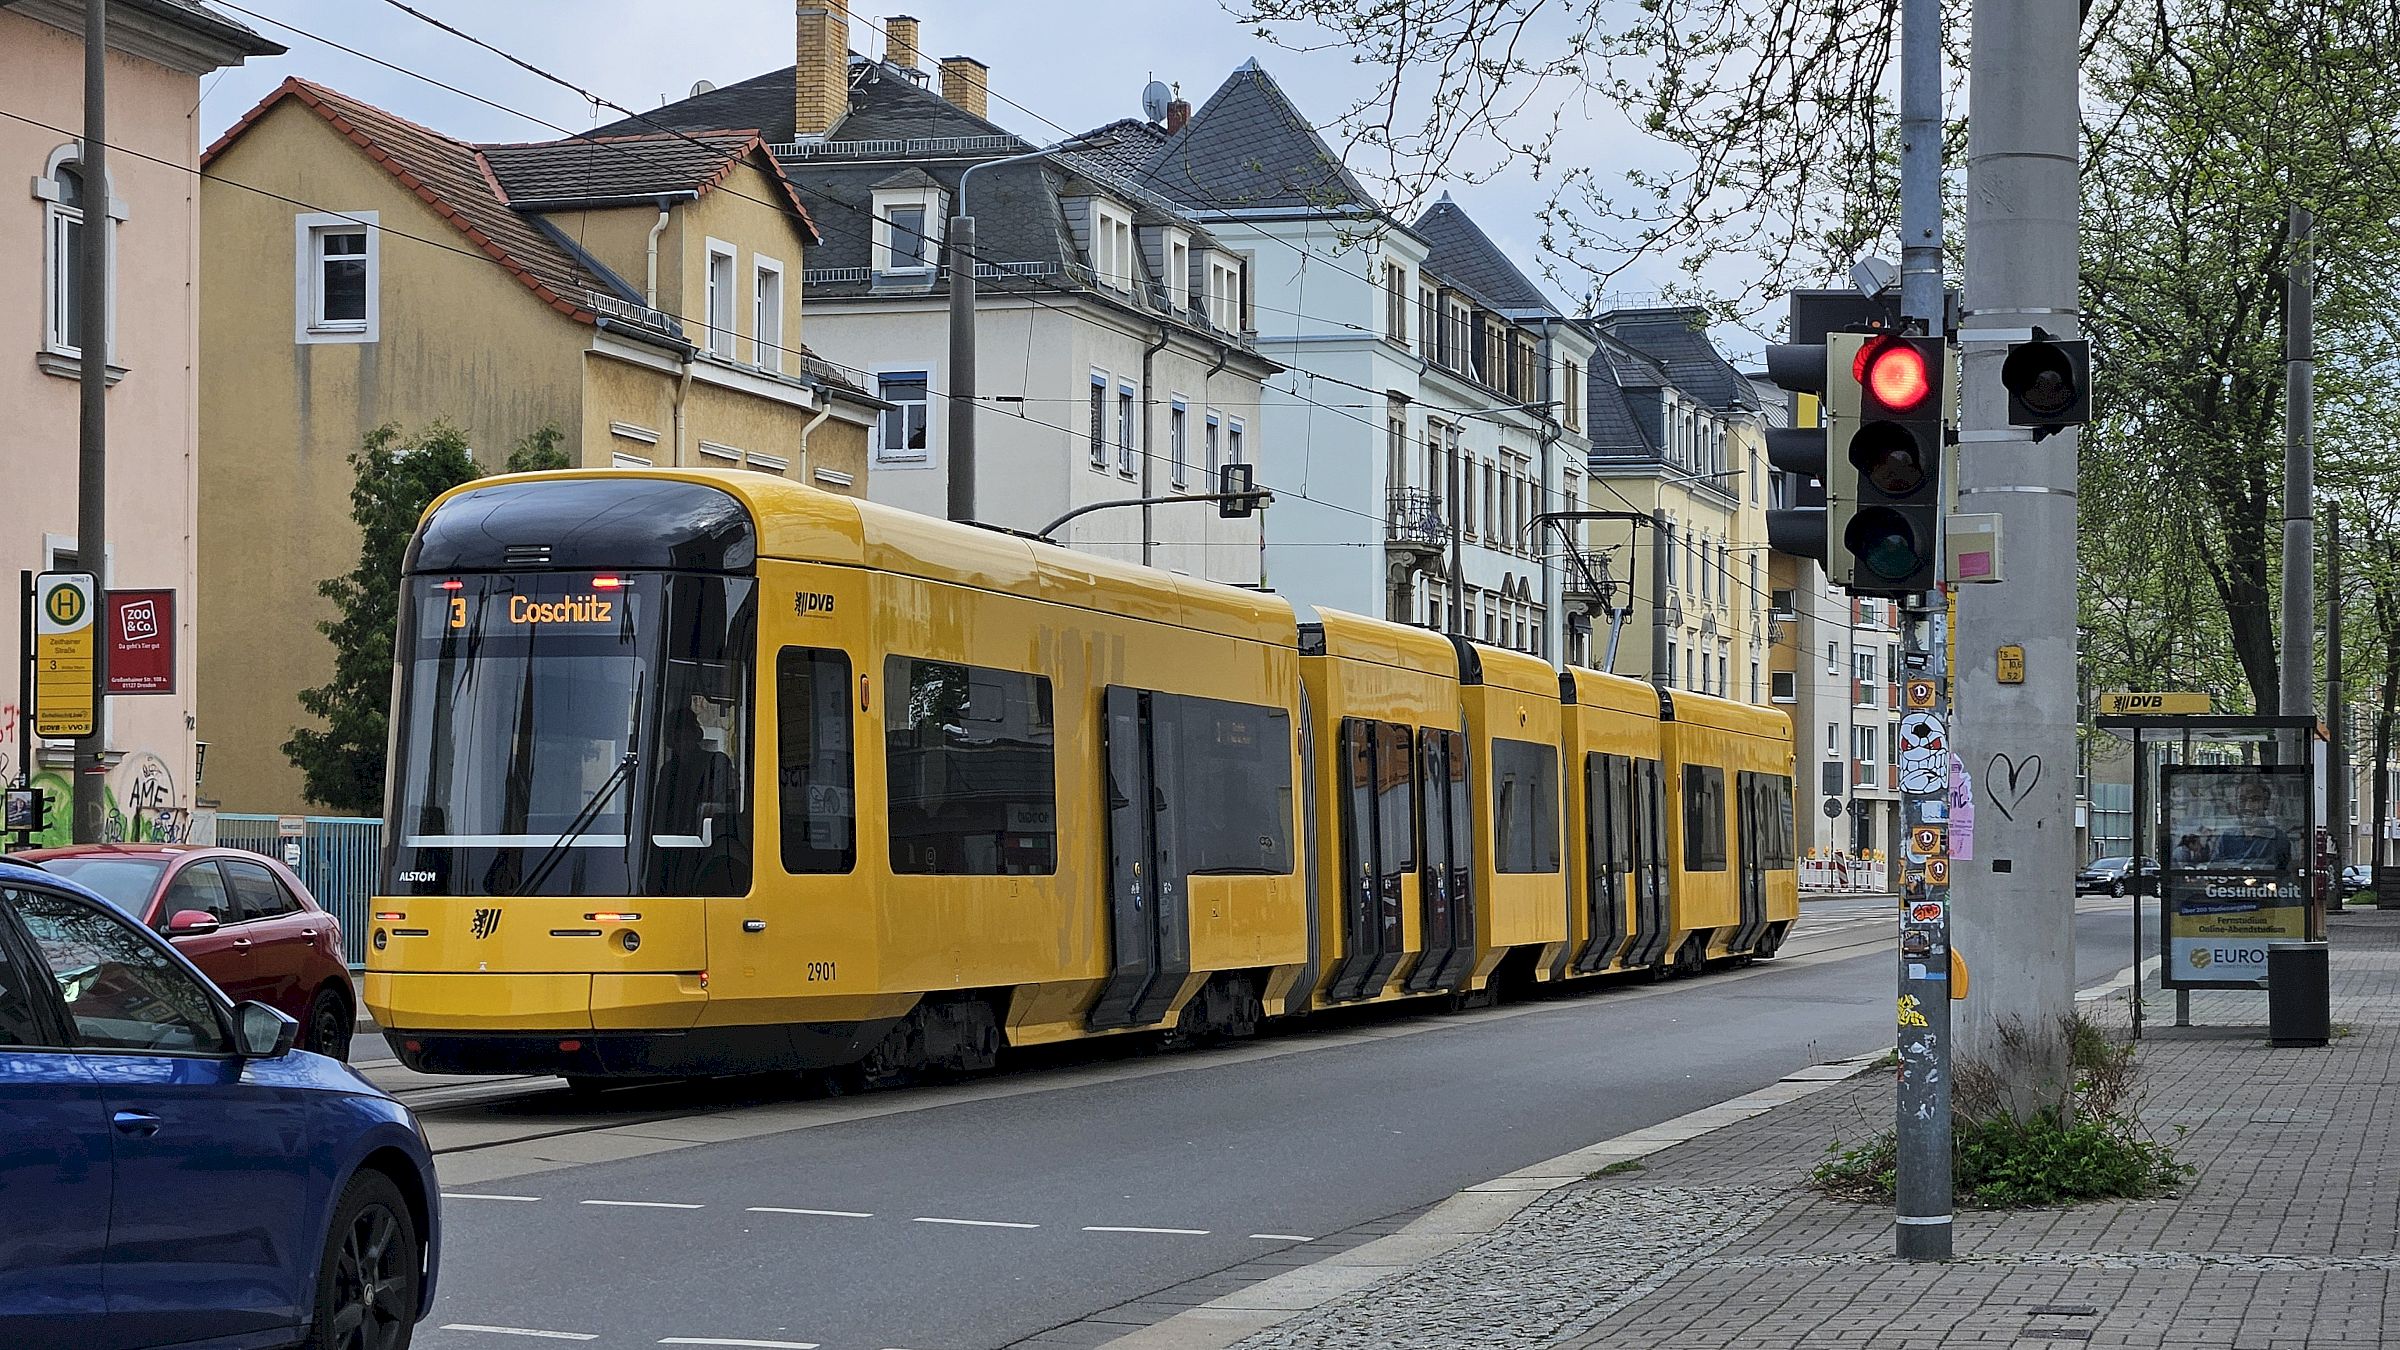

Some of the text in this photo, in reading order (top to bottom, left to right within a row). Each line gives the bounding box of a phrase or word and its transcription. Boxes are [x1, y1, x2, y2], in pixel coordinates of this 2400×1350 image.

[58, 592, 74, 616] H
[808, 593, 834, 612] DVB
[127, 609, 151, 620] ZOO
[451, 595, 612, 629] 3 Coschütz
[50, 638, 81, 646] Zeithainer
[50, 660, 57, 670] 3
[2130, 696, 2163, 708] DVB
[398, 871, 436, 882] ALSTOM
[2205, 882, 2302, 899] Gesundheit
[2217, 916, 2268, 925] Fernstudium
[2198, 925, 2286, 934] Online-Abendstudium
[807, 961, 836, 981] 2901
